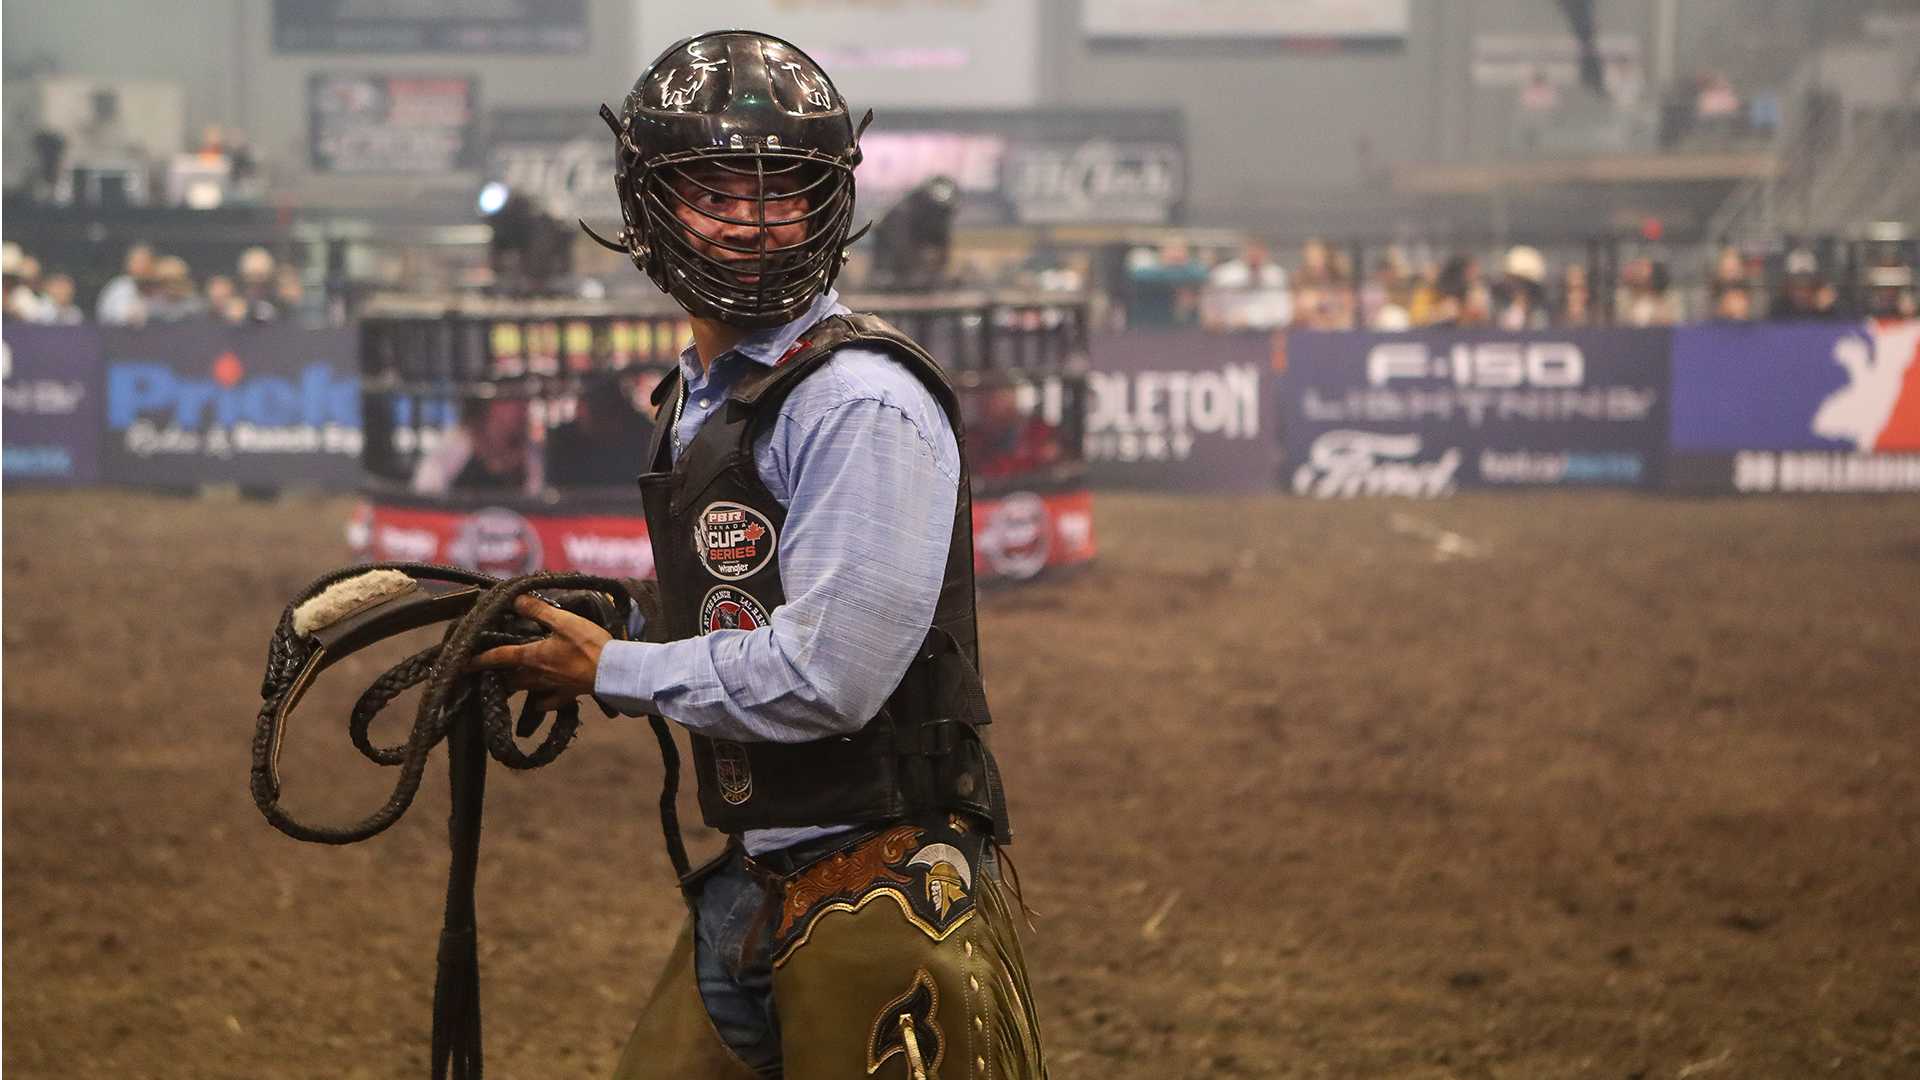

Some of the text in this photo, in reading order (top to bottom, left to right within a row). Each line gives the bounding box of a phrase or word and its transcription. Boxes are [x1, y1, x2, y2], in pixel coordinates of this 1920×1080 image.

[1367, 341, 1585, 388] F-150
[1083, 430, 1195, 462] HISKY
[1293, 429, 1460, 499] Ford
[709, 511, 742, 522] PBR
[709, 530, 745, 548] CUP
[709, 546, 757, 560] SERIES
[718, 563, 749, 576] Wrangler
[752, 608, 767, 627] RAN
